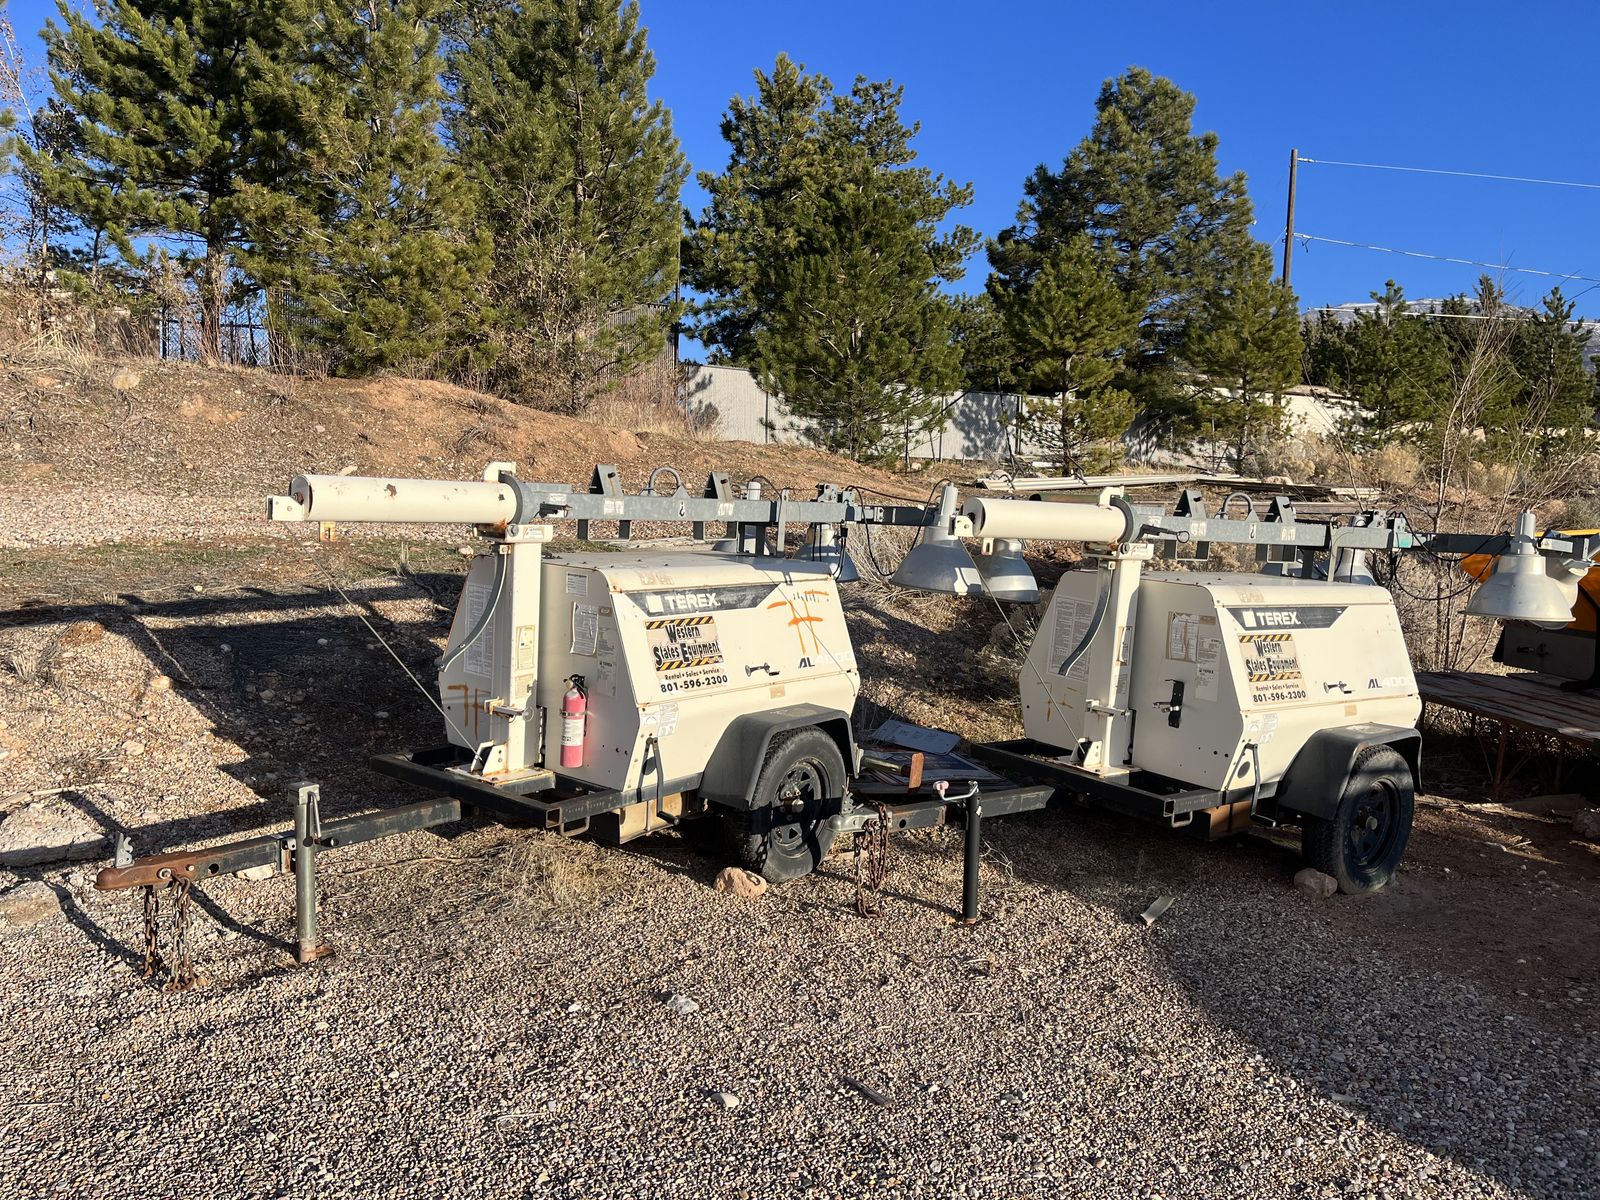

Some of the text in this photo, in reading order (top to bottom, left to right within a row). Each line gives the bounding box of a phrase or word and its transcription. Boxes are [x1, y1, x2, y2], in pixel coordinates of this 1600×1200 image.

[665, 593, 719, 610] TEREX
[1257, 611, 1300, 626] TEREX
[665, 624, 701, 643] Western
[653, 640, 721, 666] States Equipment
[1254, 639, 1283, 657] Western
[665, 667, 720, 680] Rental Sales Service
[1246, 657, 1299, 677] States Equipment
[660, 674, 728, 693] 801-596-2300
[1253, 690, 1306, 703] 801-596-2300
